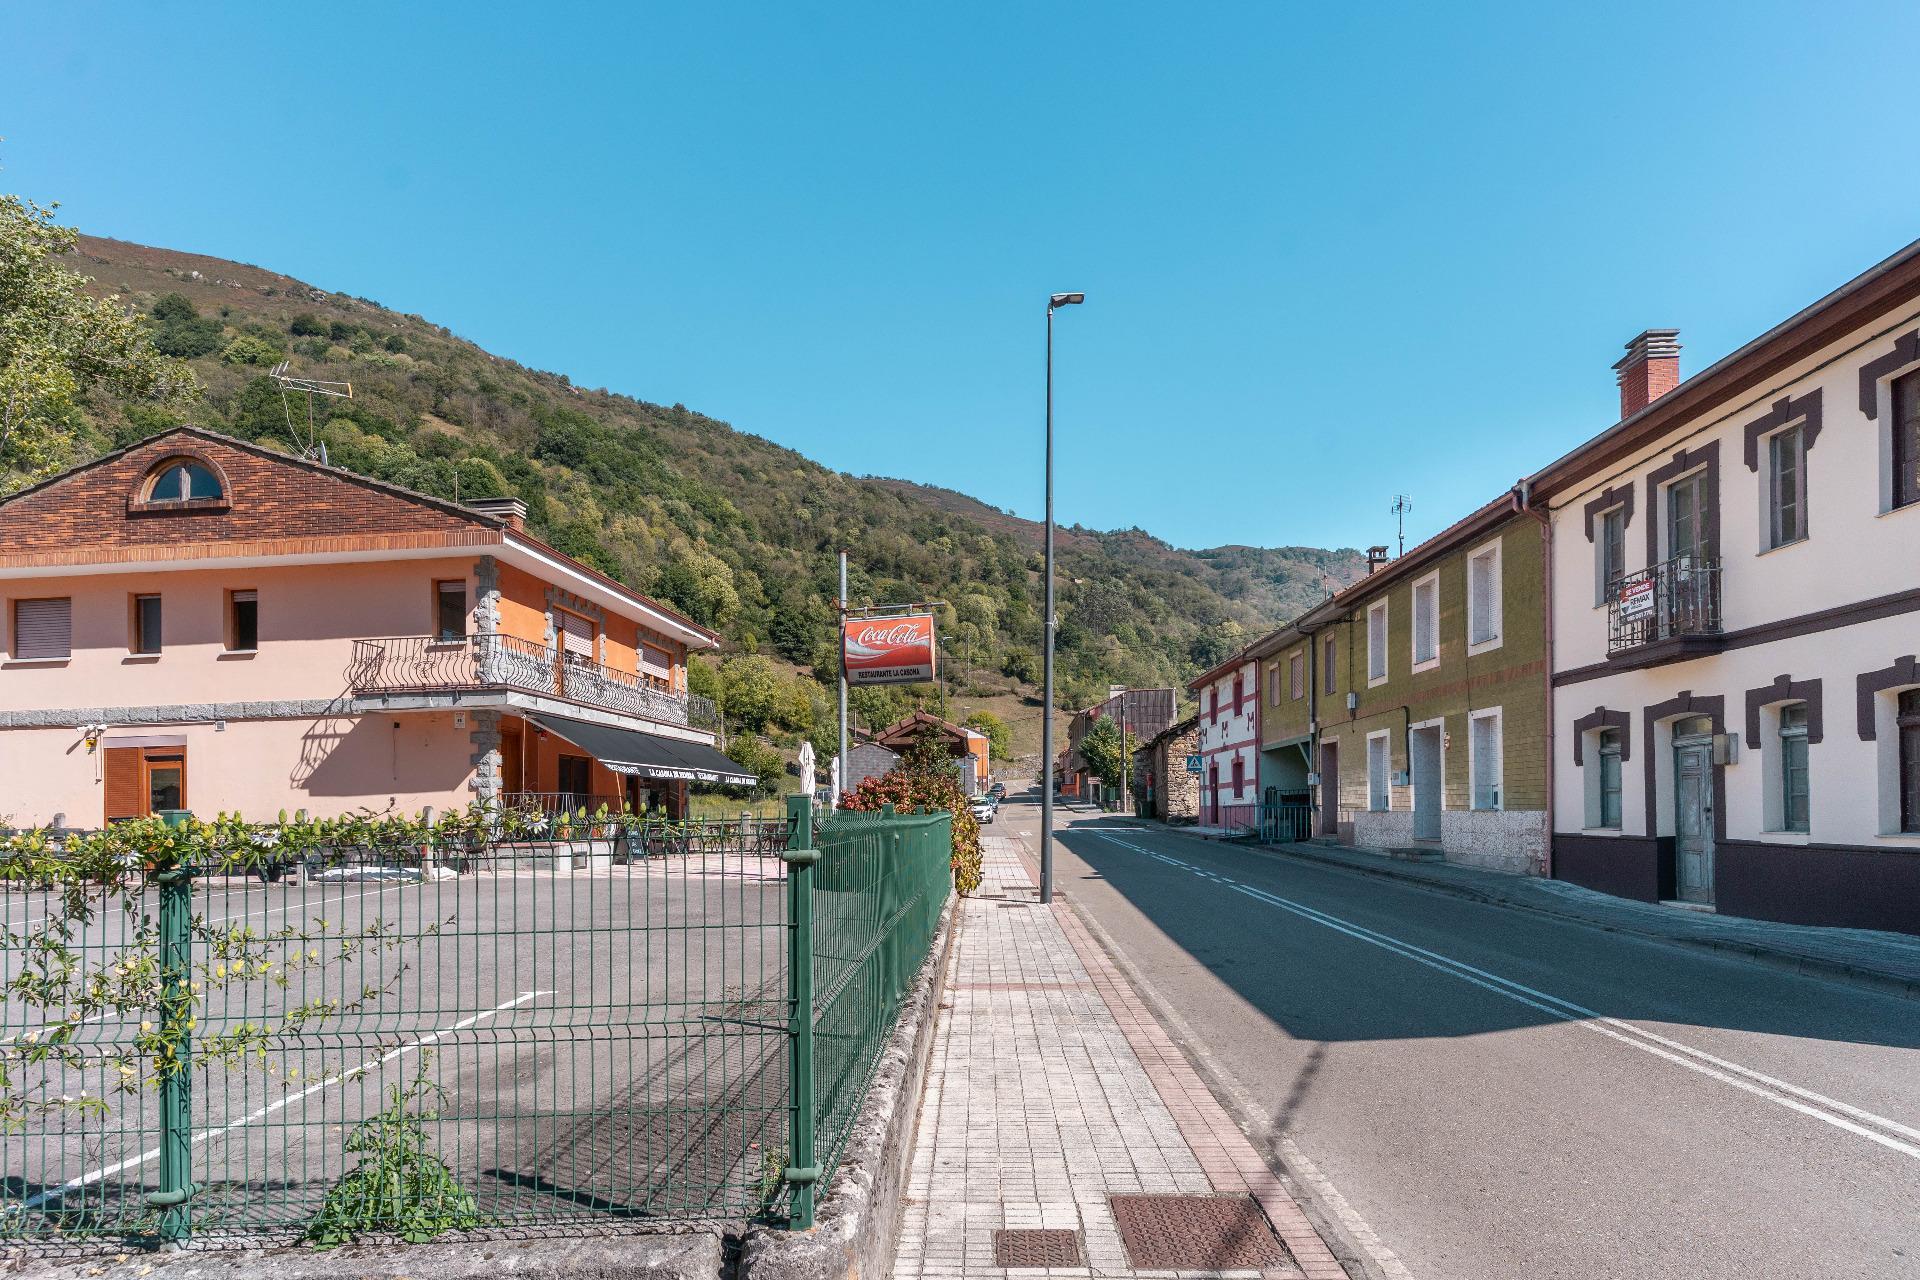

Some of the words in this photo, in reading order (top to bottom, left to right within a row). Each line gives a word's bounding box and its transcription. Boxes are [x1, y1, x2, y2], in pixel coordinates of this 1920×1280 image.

[1632, 583, 1650, 593] VENDE
[858, 624, 920, 646] Coca-Cola
[858, 670, 892, 678] RESTAURANTE
